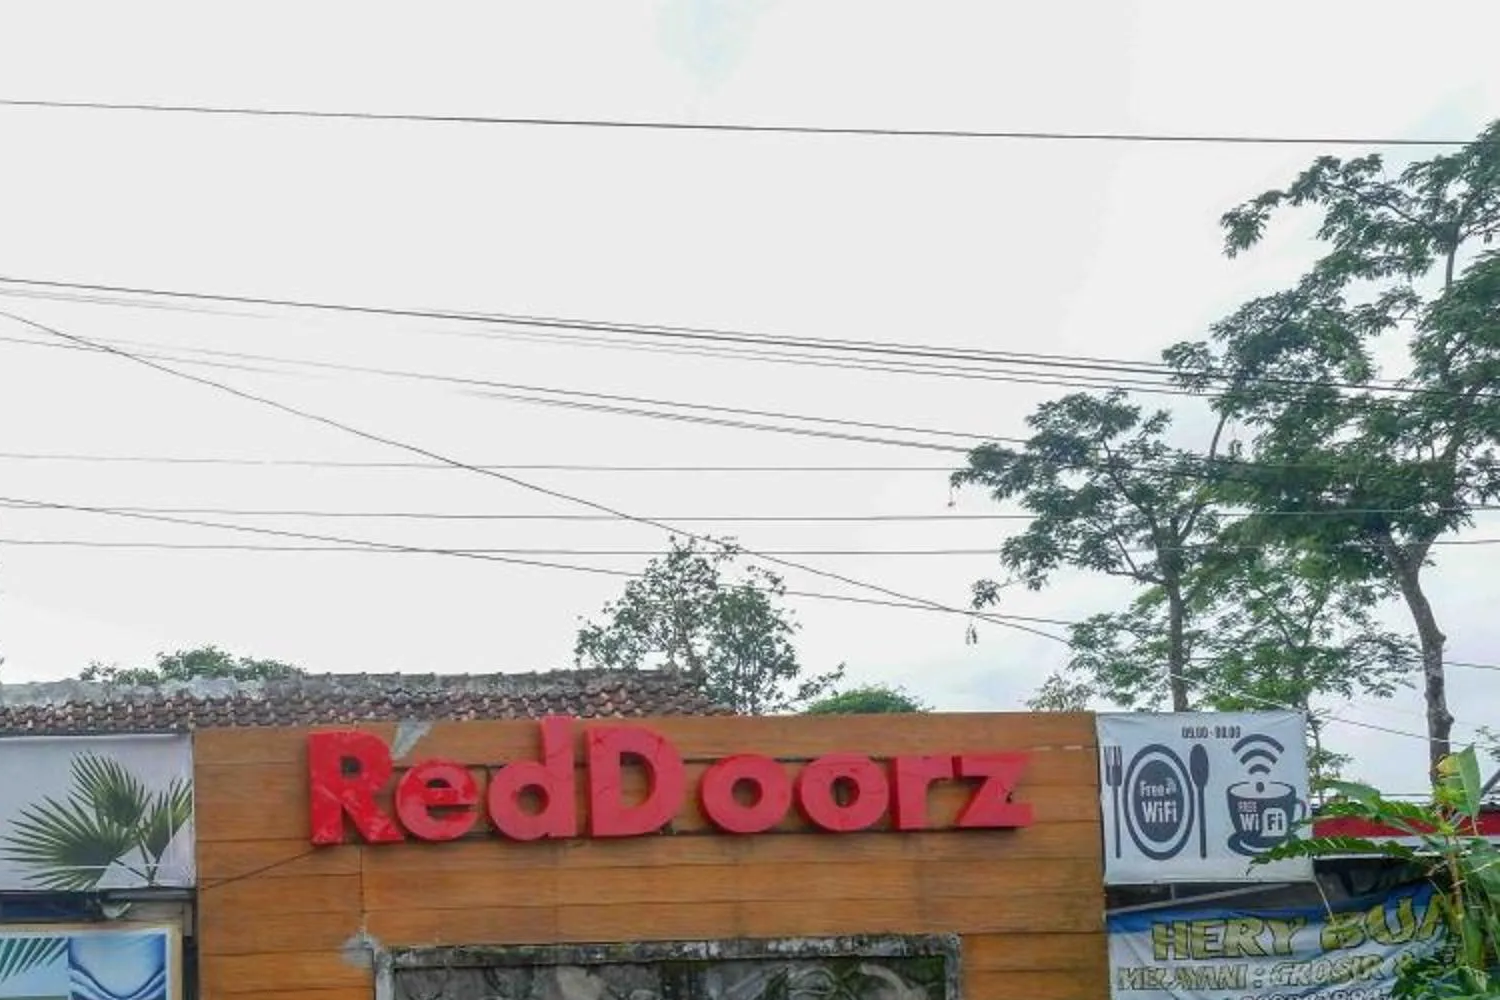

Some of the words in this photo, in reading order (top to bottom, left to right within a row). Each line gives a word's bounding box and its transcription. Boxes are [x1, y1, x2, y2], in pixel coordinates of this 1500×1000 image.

[307, 717, 1033, 845] RedDoorz
[1140, 780, 1165, 796] Free
[1141, 800, 1177, 822] WiFi
[1152, 917, 1307, 960] HERY
[1117, 963, 1248, 991] MELAYANI
